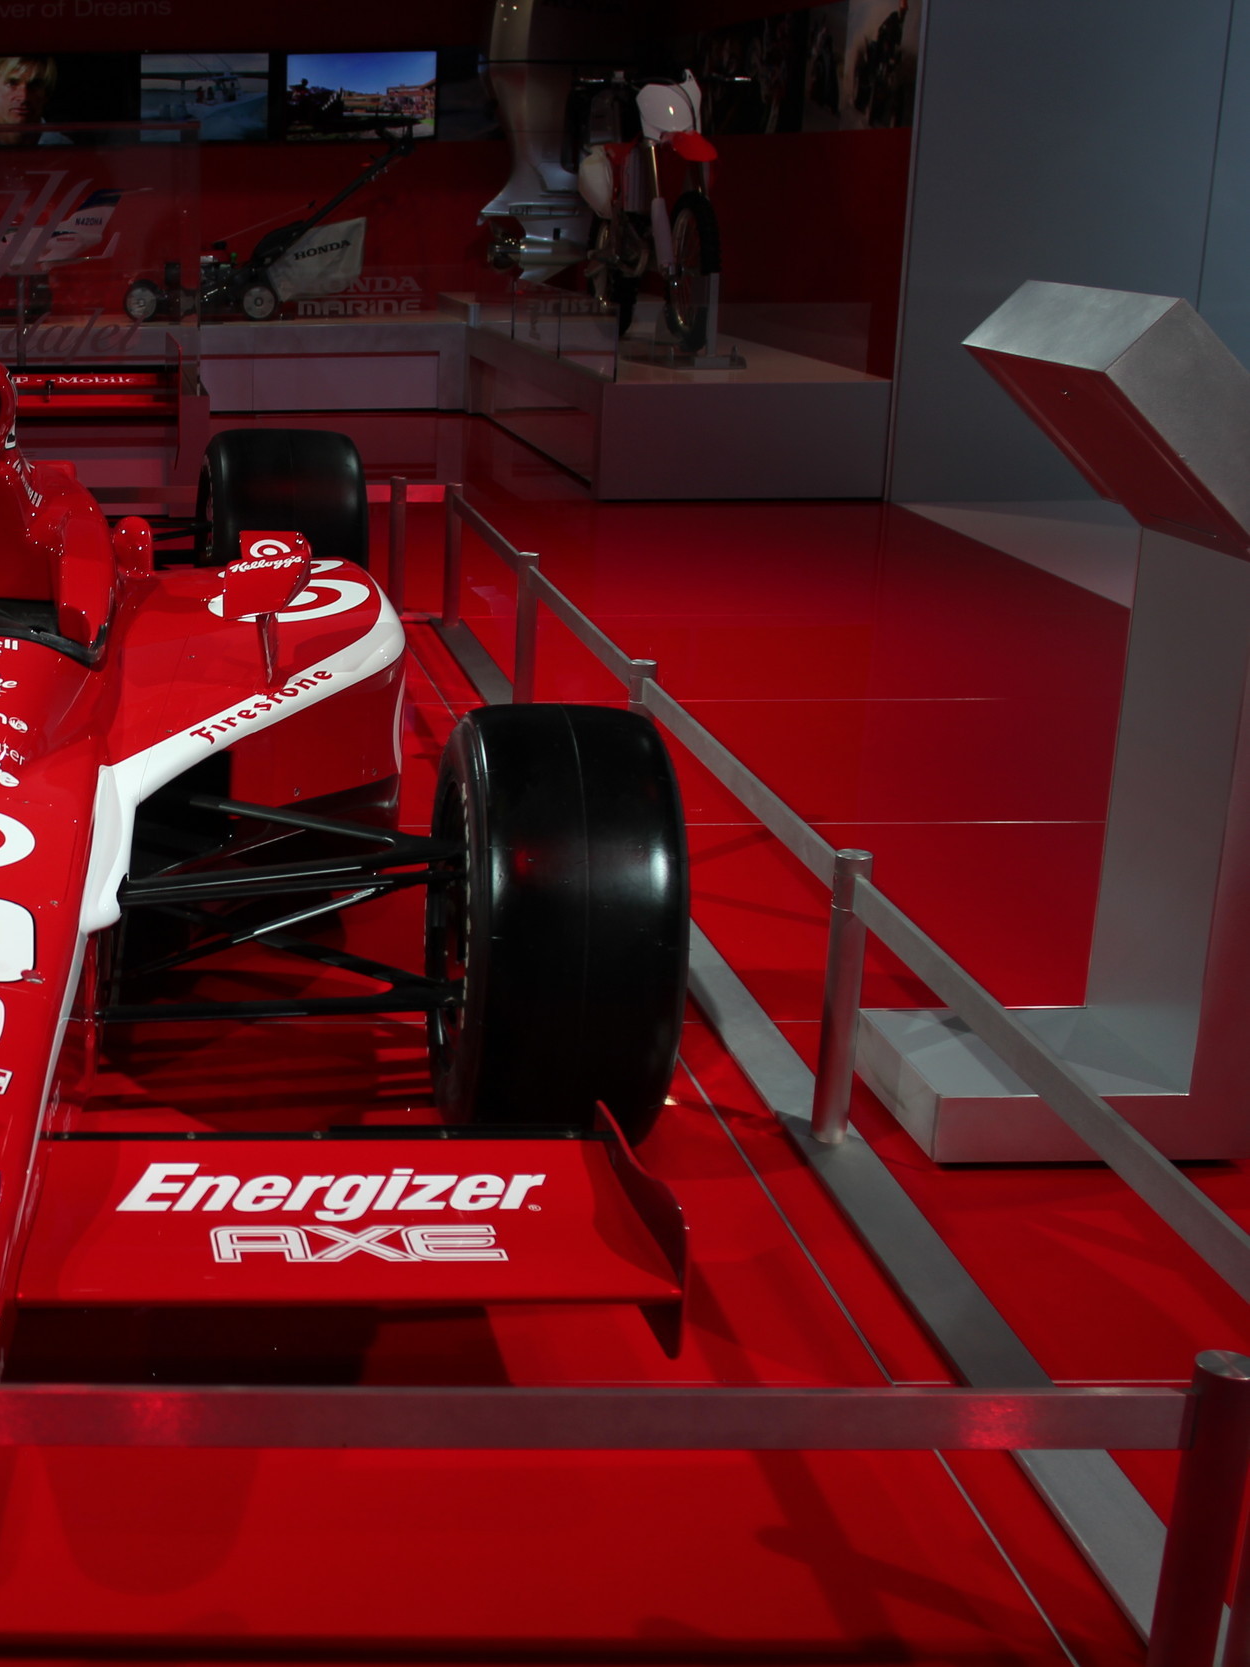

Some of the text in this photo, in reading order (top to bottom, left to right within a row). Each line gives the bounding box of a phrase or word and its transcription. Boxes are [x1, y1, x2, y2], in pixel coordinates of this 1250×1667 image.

[40, 0, 64, 17] of
[73, 0, 173, 17] Dreams
[294, 240, 352, 260] HONDA
[230, 555, 302, 573] Kellogg's
[189, 669, 334, 745] Firestone
[115, 1162, 547, 1222] Energizer
[209, 1225, 510, 1263] AXE
